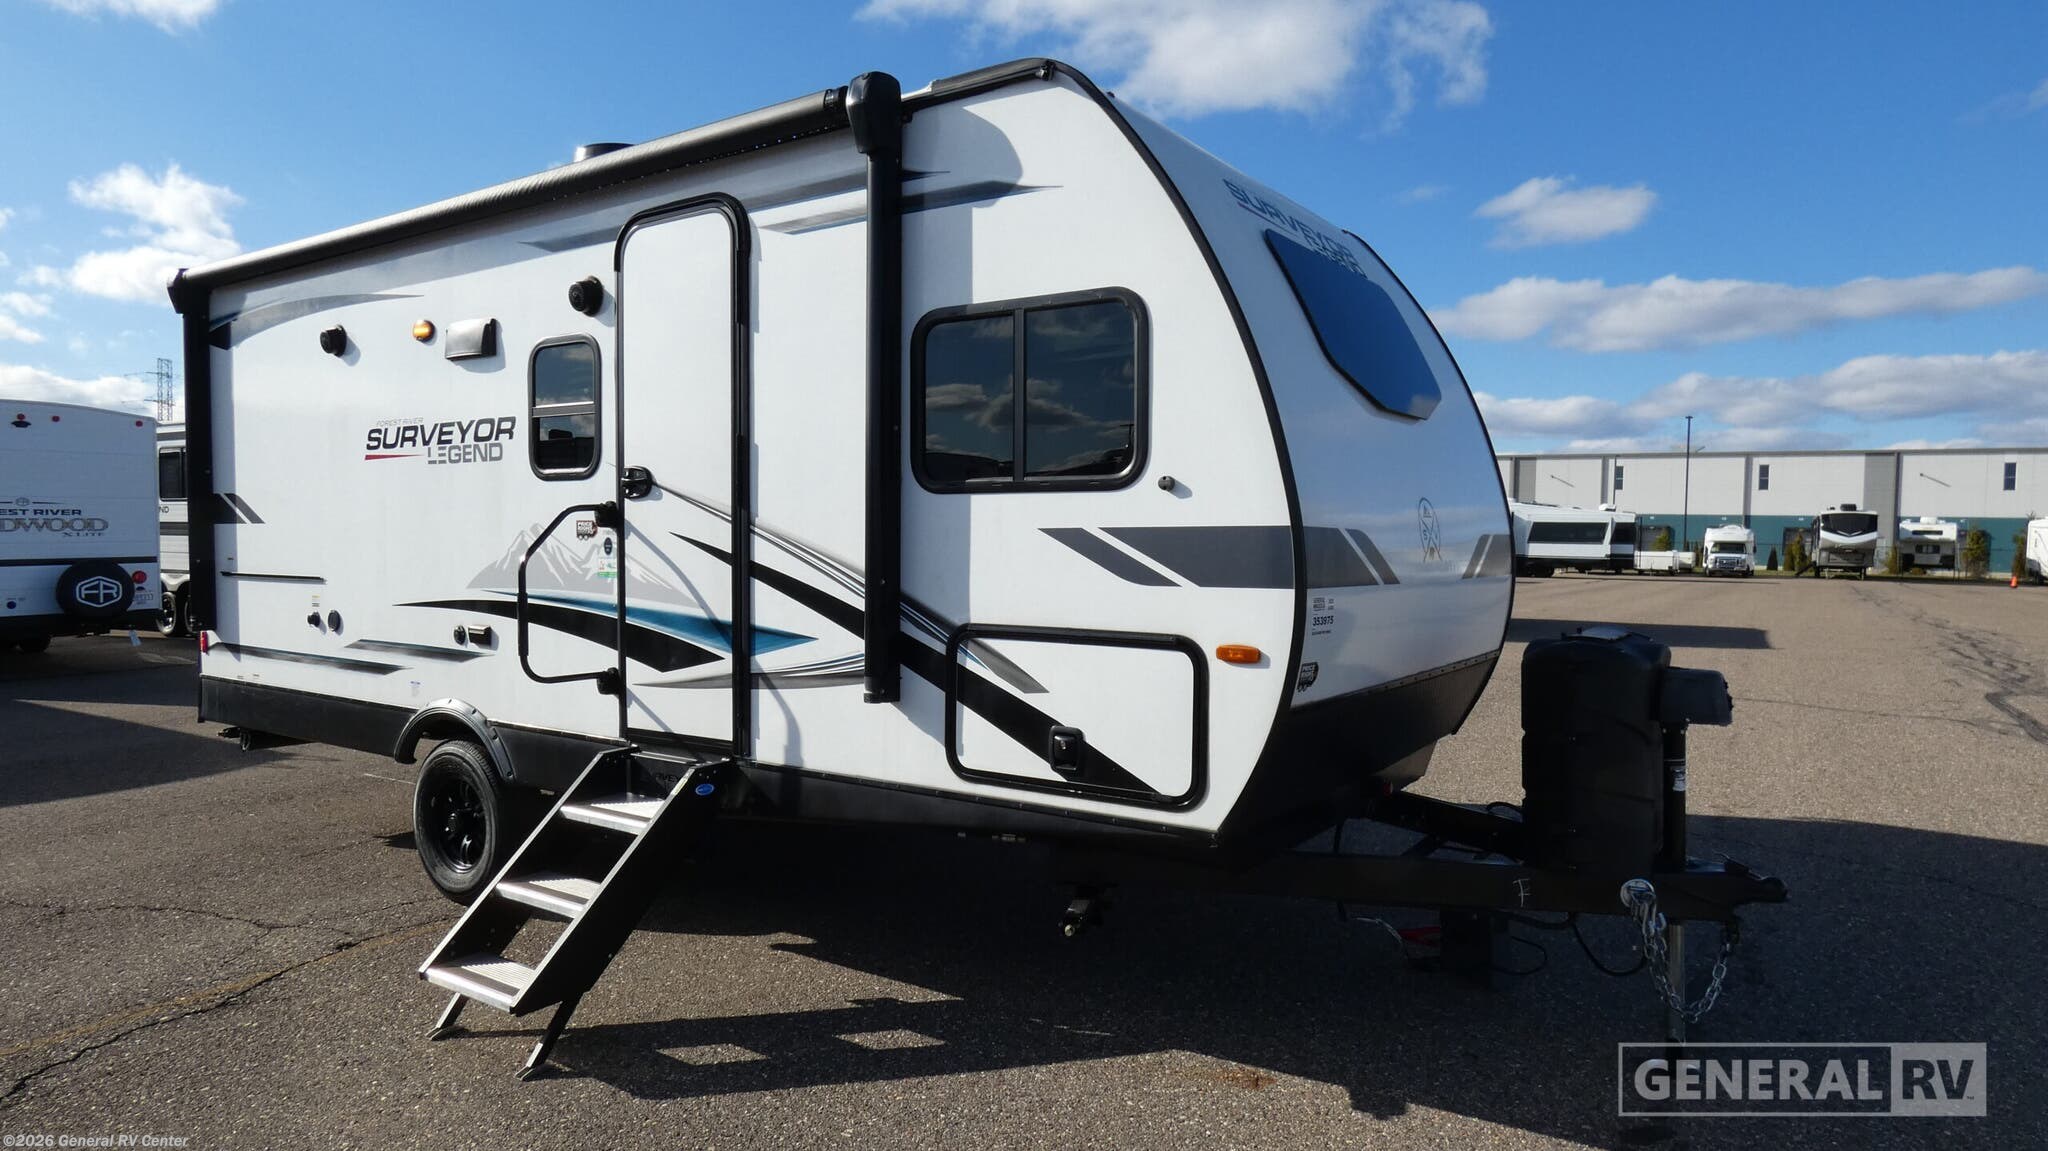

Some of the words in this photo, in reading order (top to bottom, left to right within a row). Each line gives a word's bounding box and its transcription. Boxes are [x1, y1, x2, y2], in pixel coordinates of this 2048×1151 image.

[366, 416, 517, 450] SURVEYOR
[427, 443, 504, 465] LEGEND
[33, 508, 82, 516] RIVER
[1312, 616, 1334, 626] 353975
